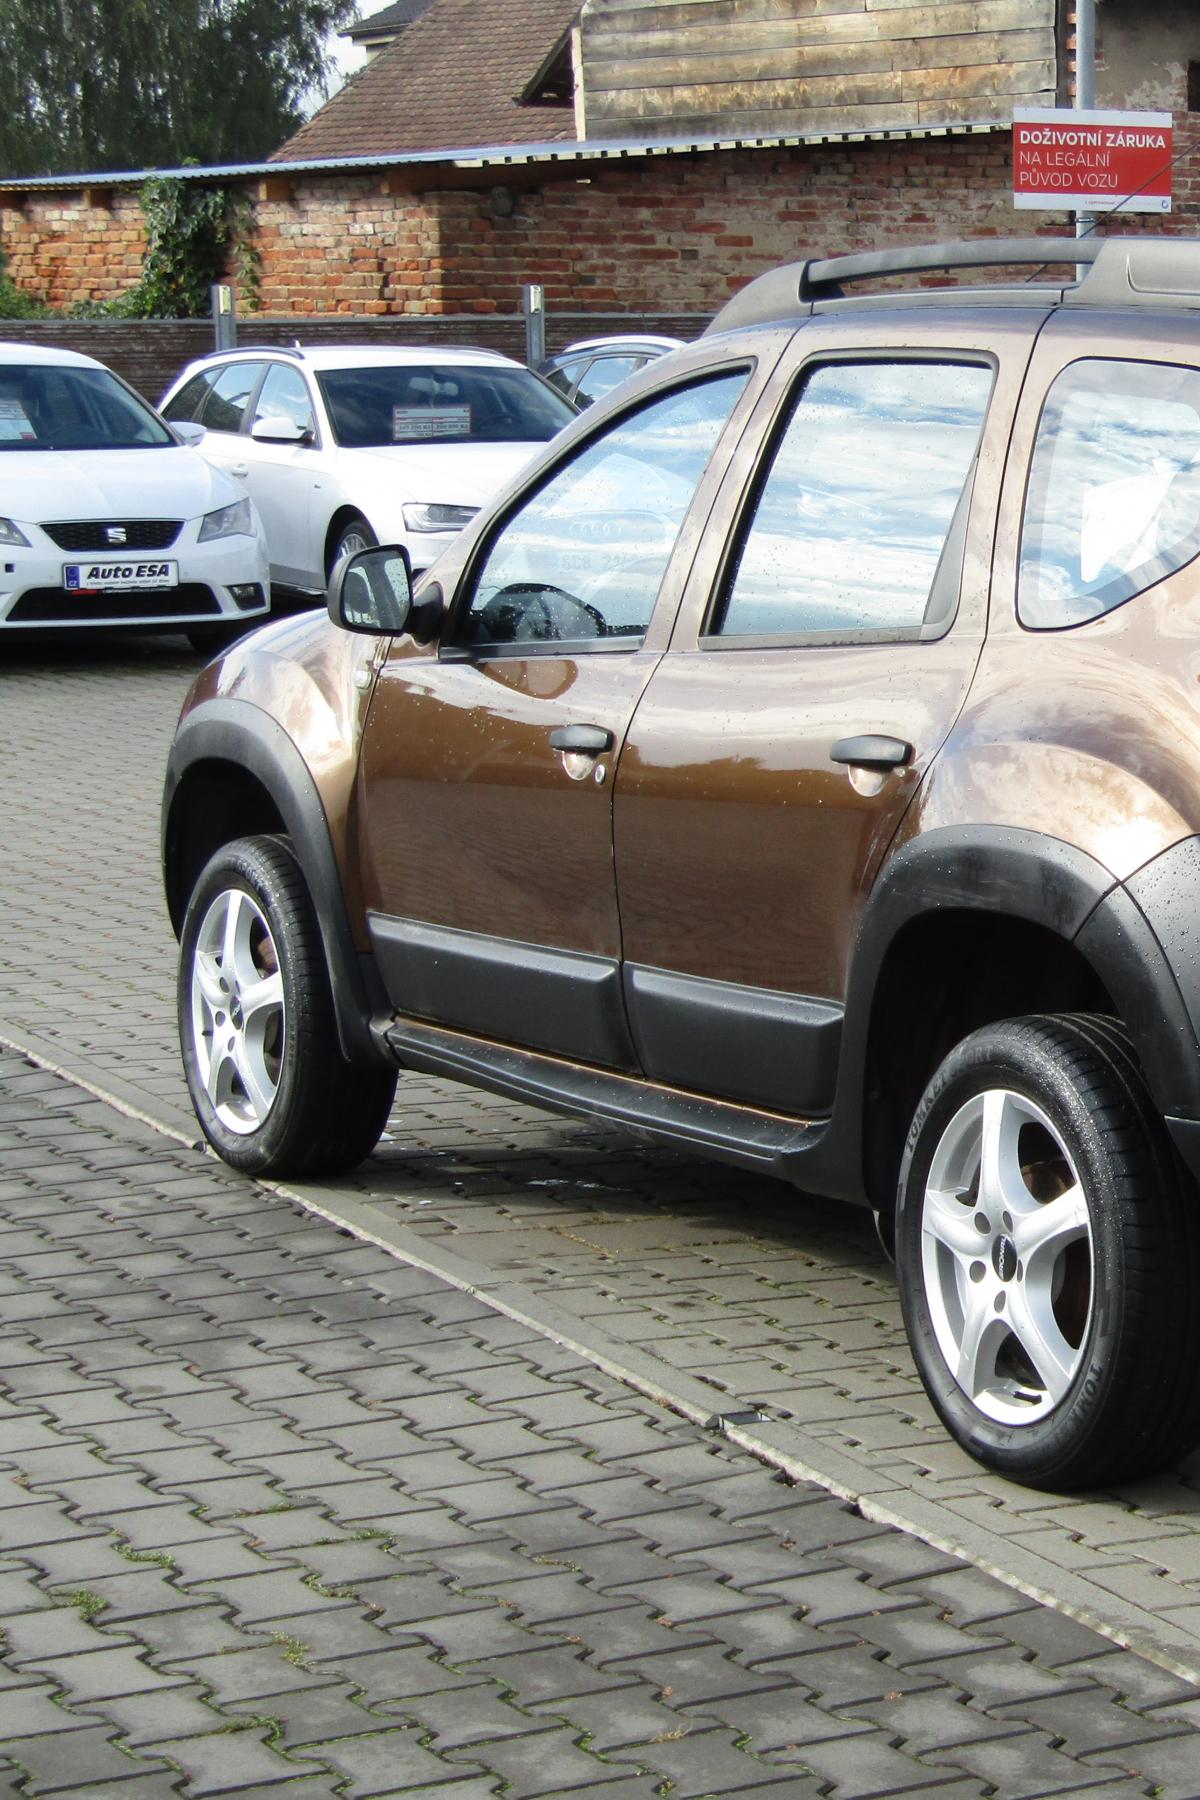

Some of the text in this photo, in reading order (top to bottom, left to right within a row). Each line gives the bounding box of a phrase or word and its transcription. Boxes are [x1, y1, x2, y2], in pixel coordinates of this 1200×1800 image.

[1020, 128, 1166, 149] DOŽIVOTNÍ ZÁRUKA
[1019, 150, 1111, 167] NA LEGÁLNÍ
[1019, 168, 1119, 188] PŮVOD VOZU
[87, 564, 169, 579] Auto ESA
